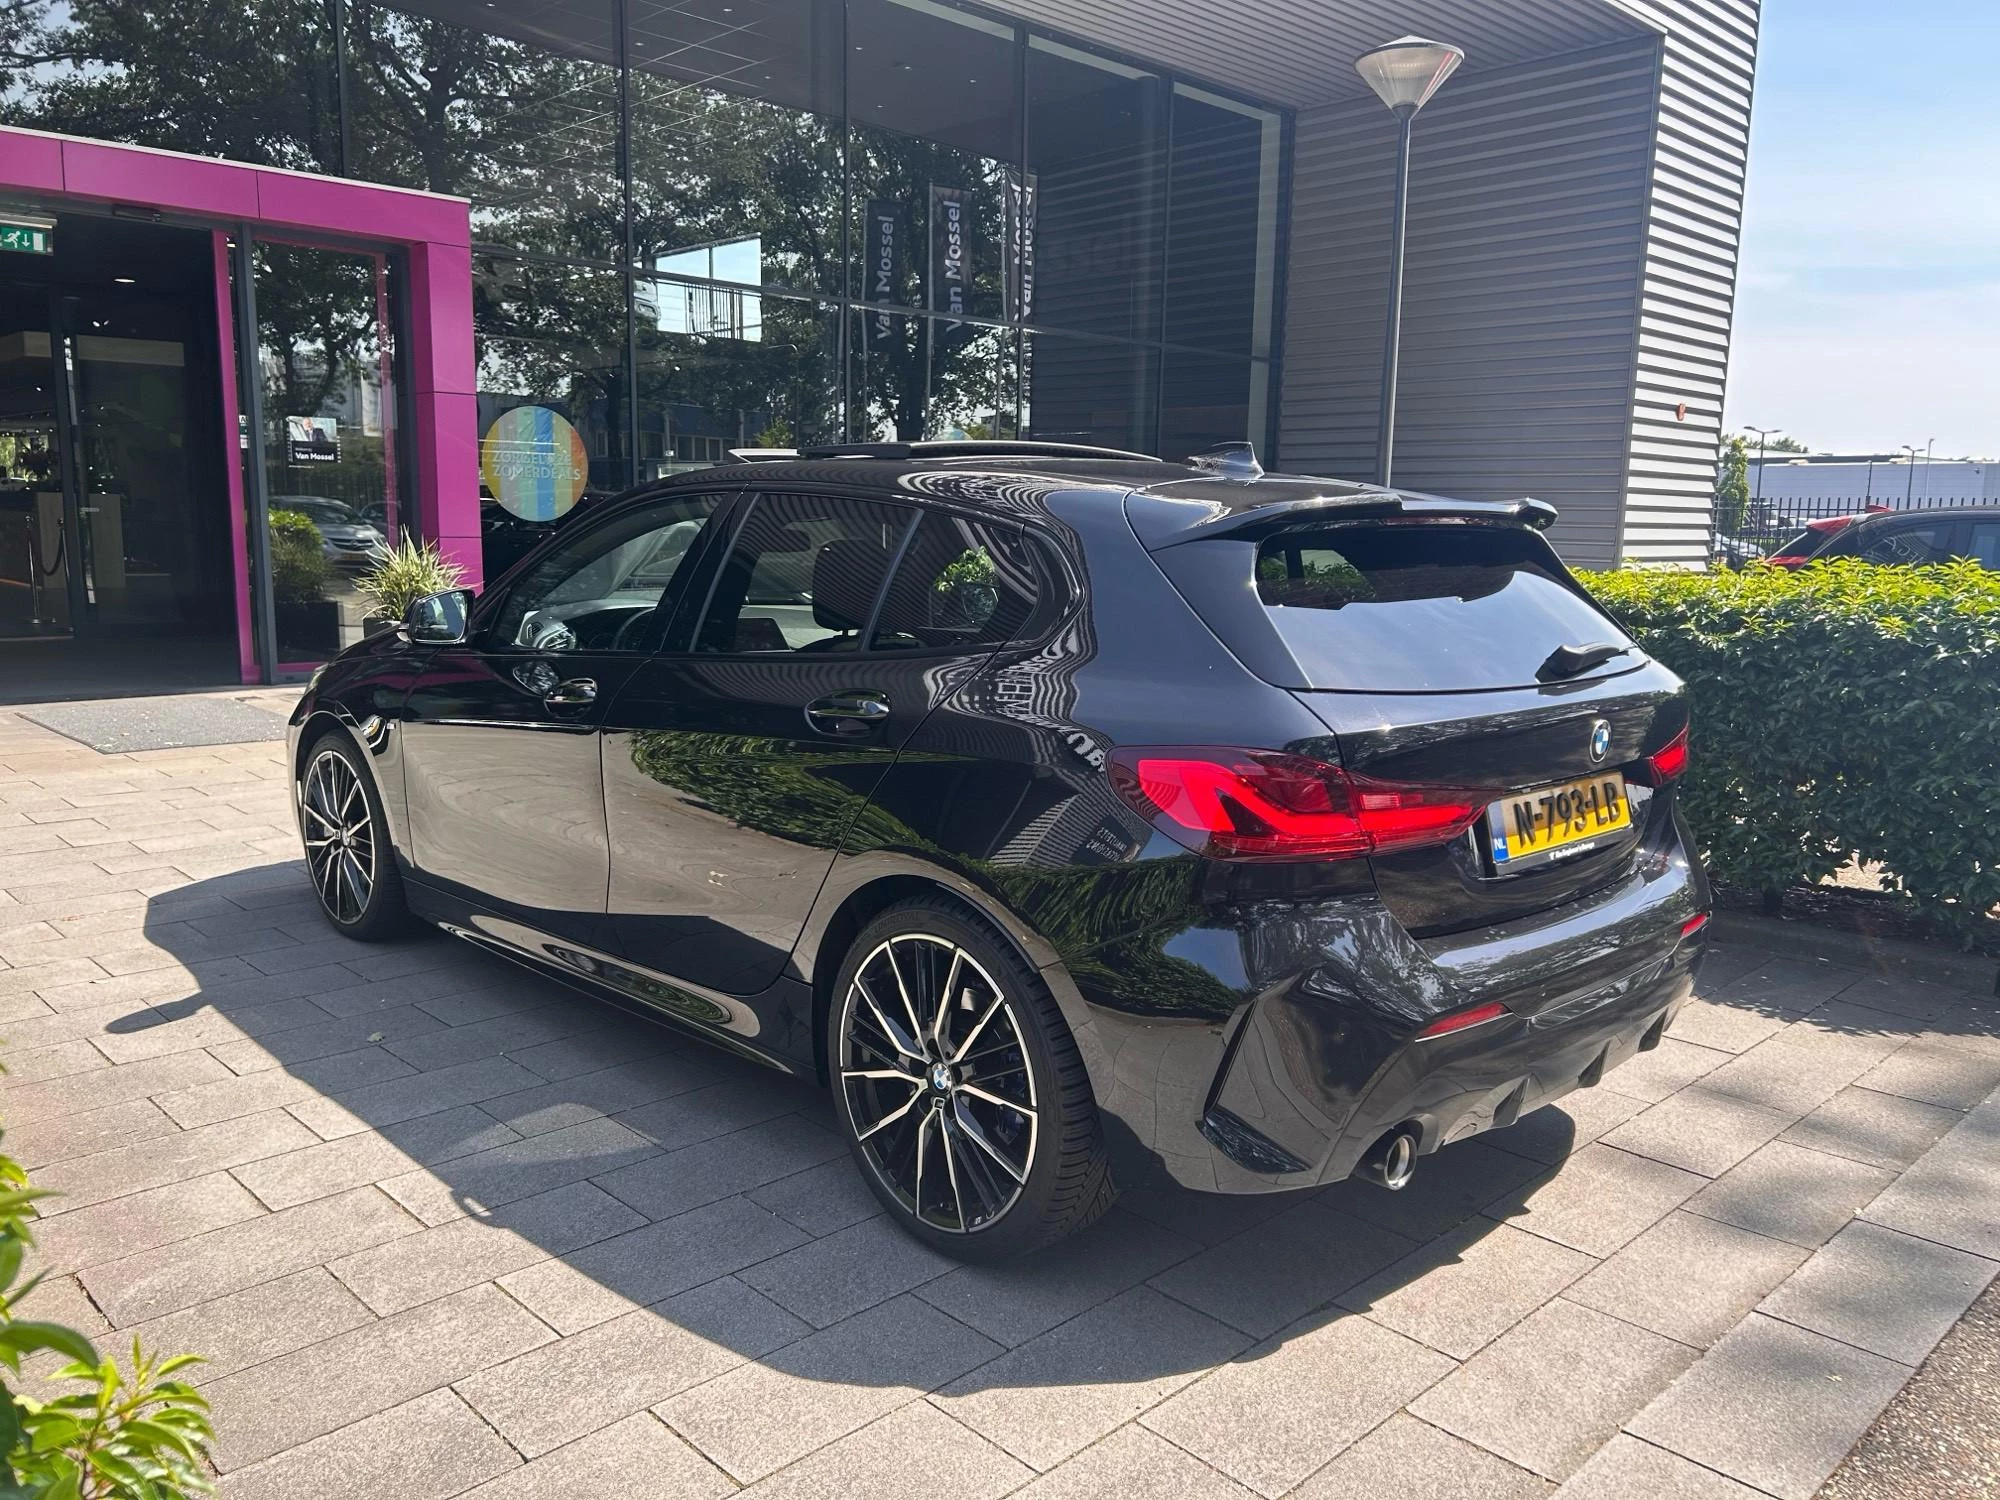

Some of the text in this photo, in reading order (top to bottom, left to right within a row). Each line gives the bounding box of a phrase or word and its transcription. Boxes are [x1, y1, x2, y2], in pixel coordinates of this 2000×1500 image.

[875, 216, 895, 293] Mossel
[943, 200, 962, 280] Mossel
[295, 452, 335, 461] Van Mossel
[492, 464, 581, 481] ZOMERDEALS
[1513, 782, 1621, 848] N-793-LB
[1494, 838, 1507, 850] NL
